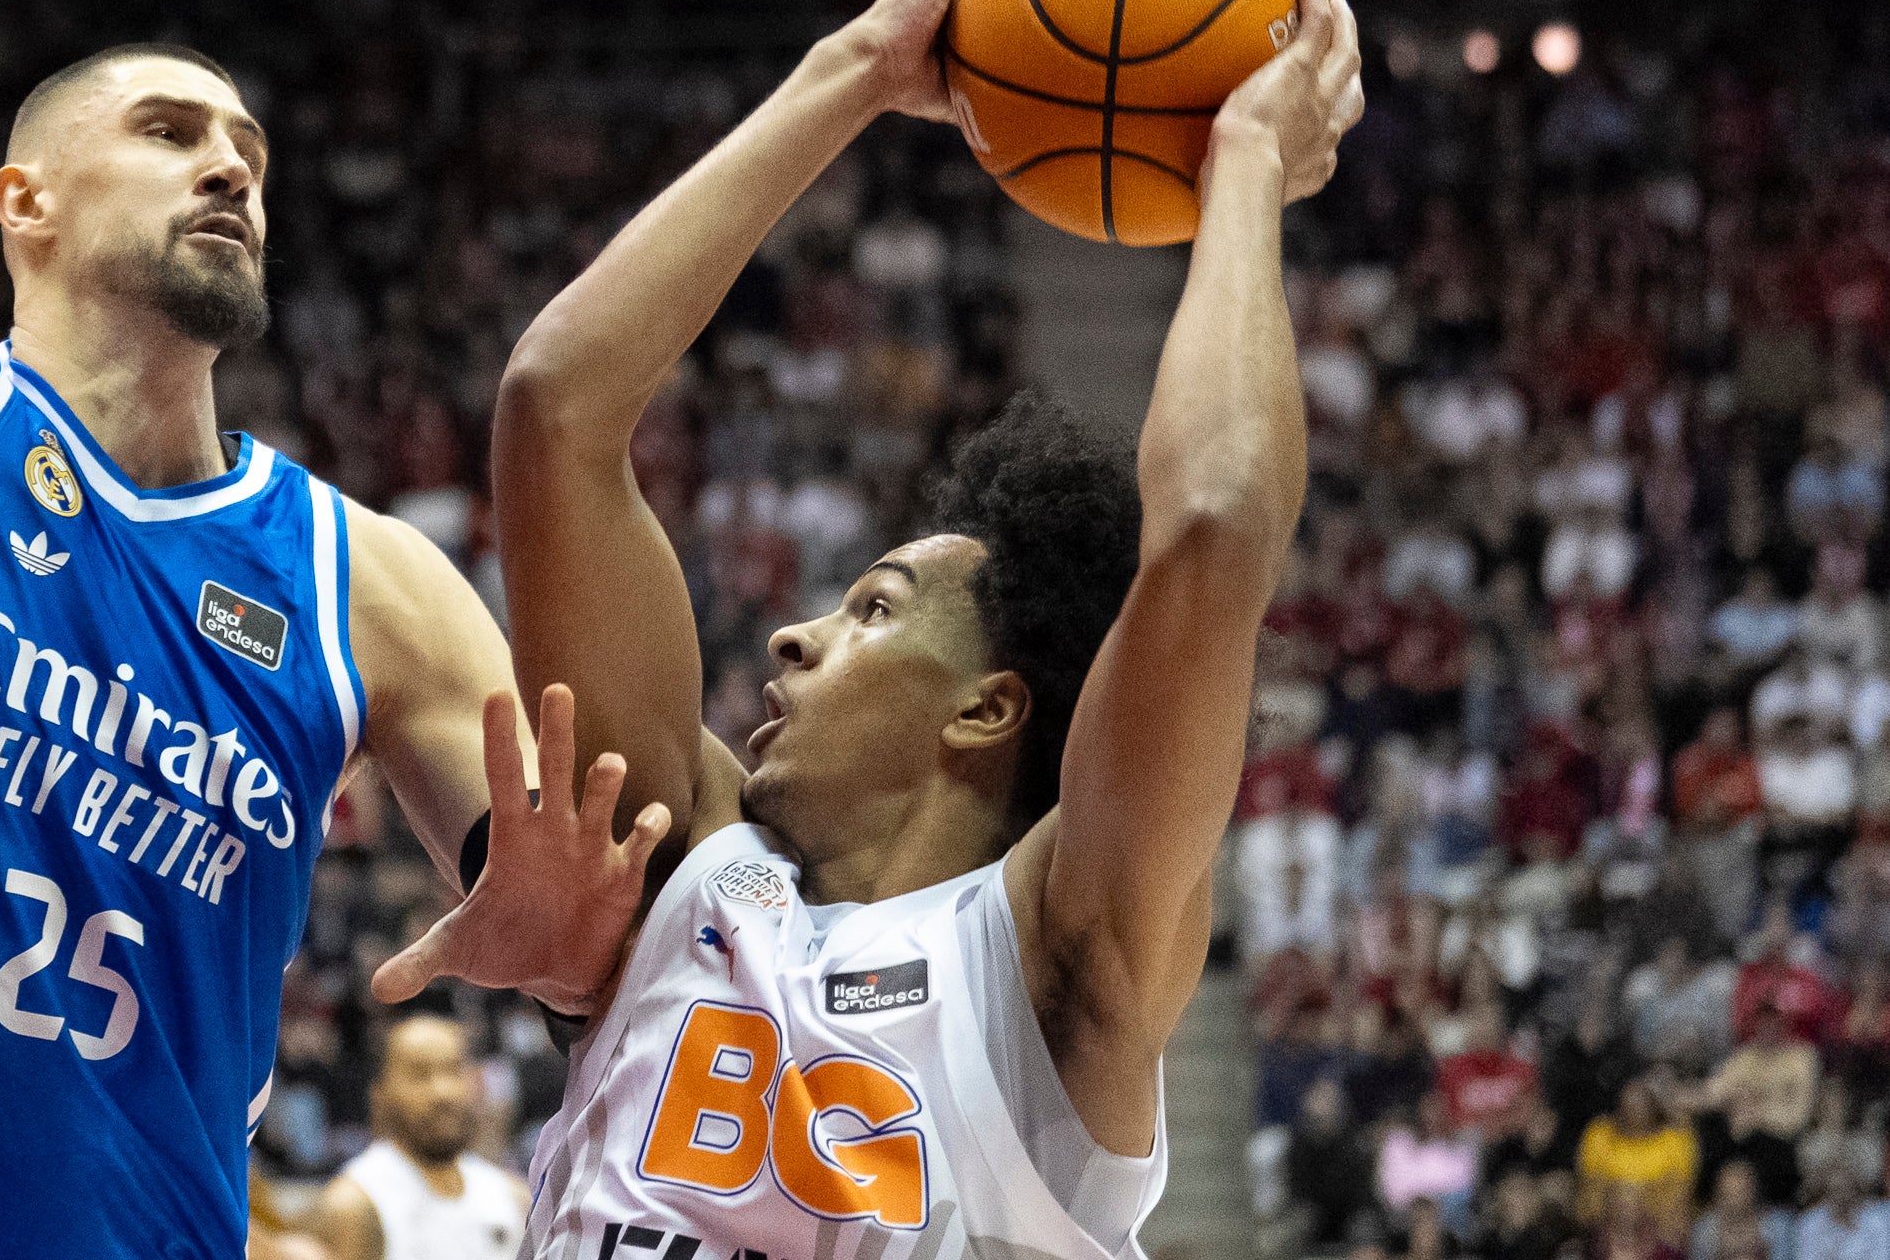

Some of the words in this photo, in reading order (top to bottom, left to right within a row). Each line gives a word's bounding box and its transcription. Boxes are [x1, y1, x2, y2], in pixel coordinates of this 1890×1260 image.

[208, 600, 241, 627] liga
[205, 619, 275, 661] endesa
[72, 767, 247, 905] BETTER
[712, 872, 774, 909] GIRONA
[833, 983, 876, 1000] liga
[833, 987, 924, 1012] endesa
[637, 999, 929, 1232] BG
